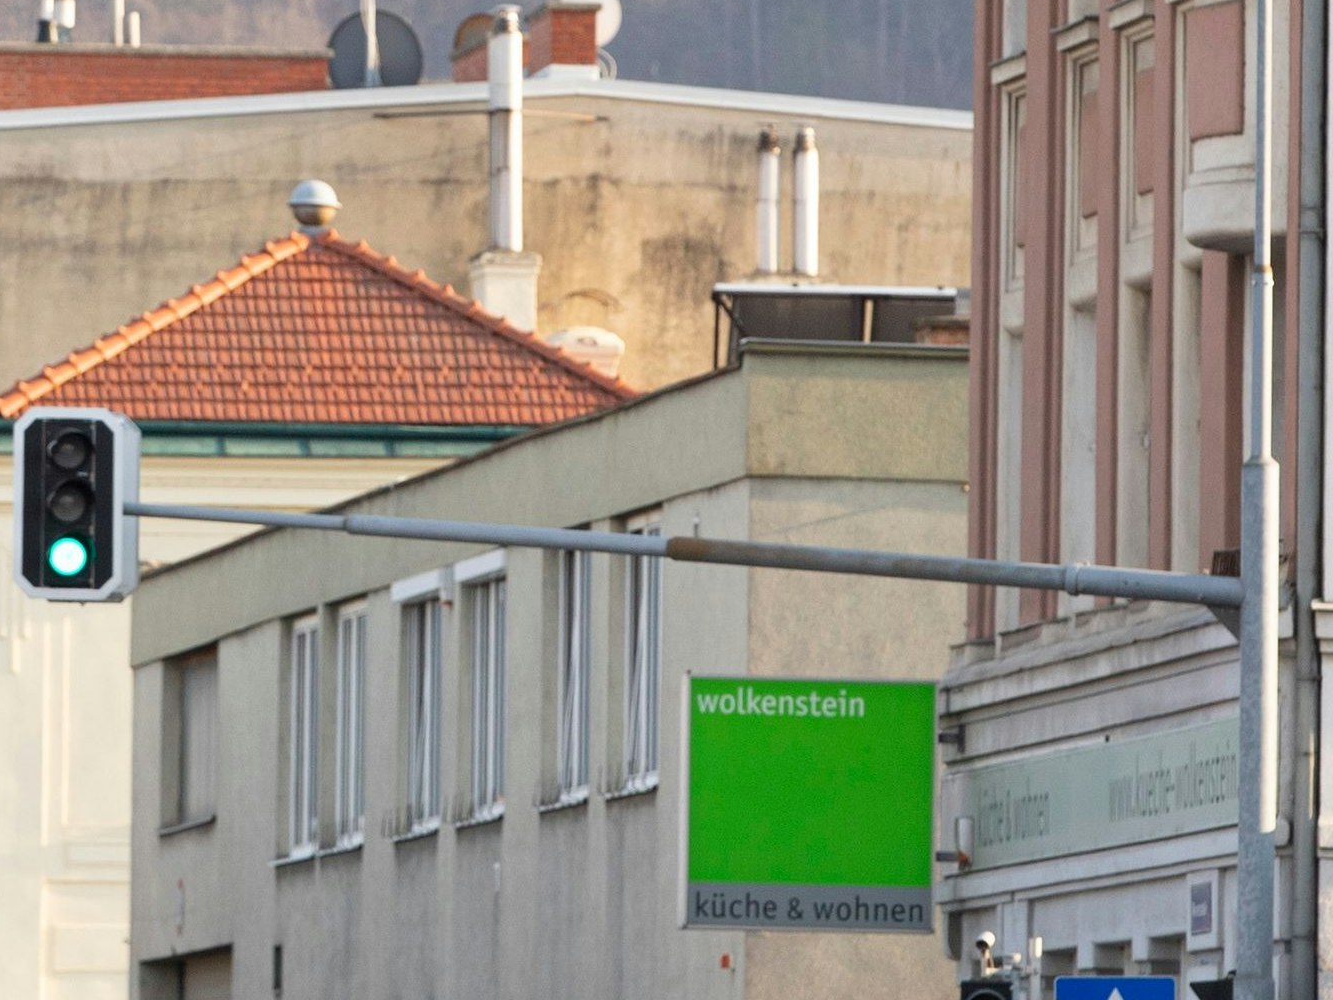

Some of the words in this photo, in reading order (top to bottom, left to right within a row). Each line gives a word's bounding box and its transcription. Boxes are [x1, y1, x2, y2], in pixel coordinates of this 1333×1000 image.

[697, 686, 866, 717] wolkenstein
[695, 891, 777, 920] küche
[787, 897, 804, 921] &
[813, 894, 924, 923] wohnen
